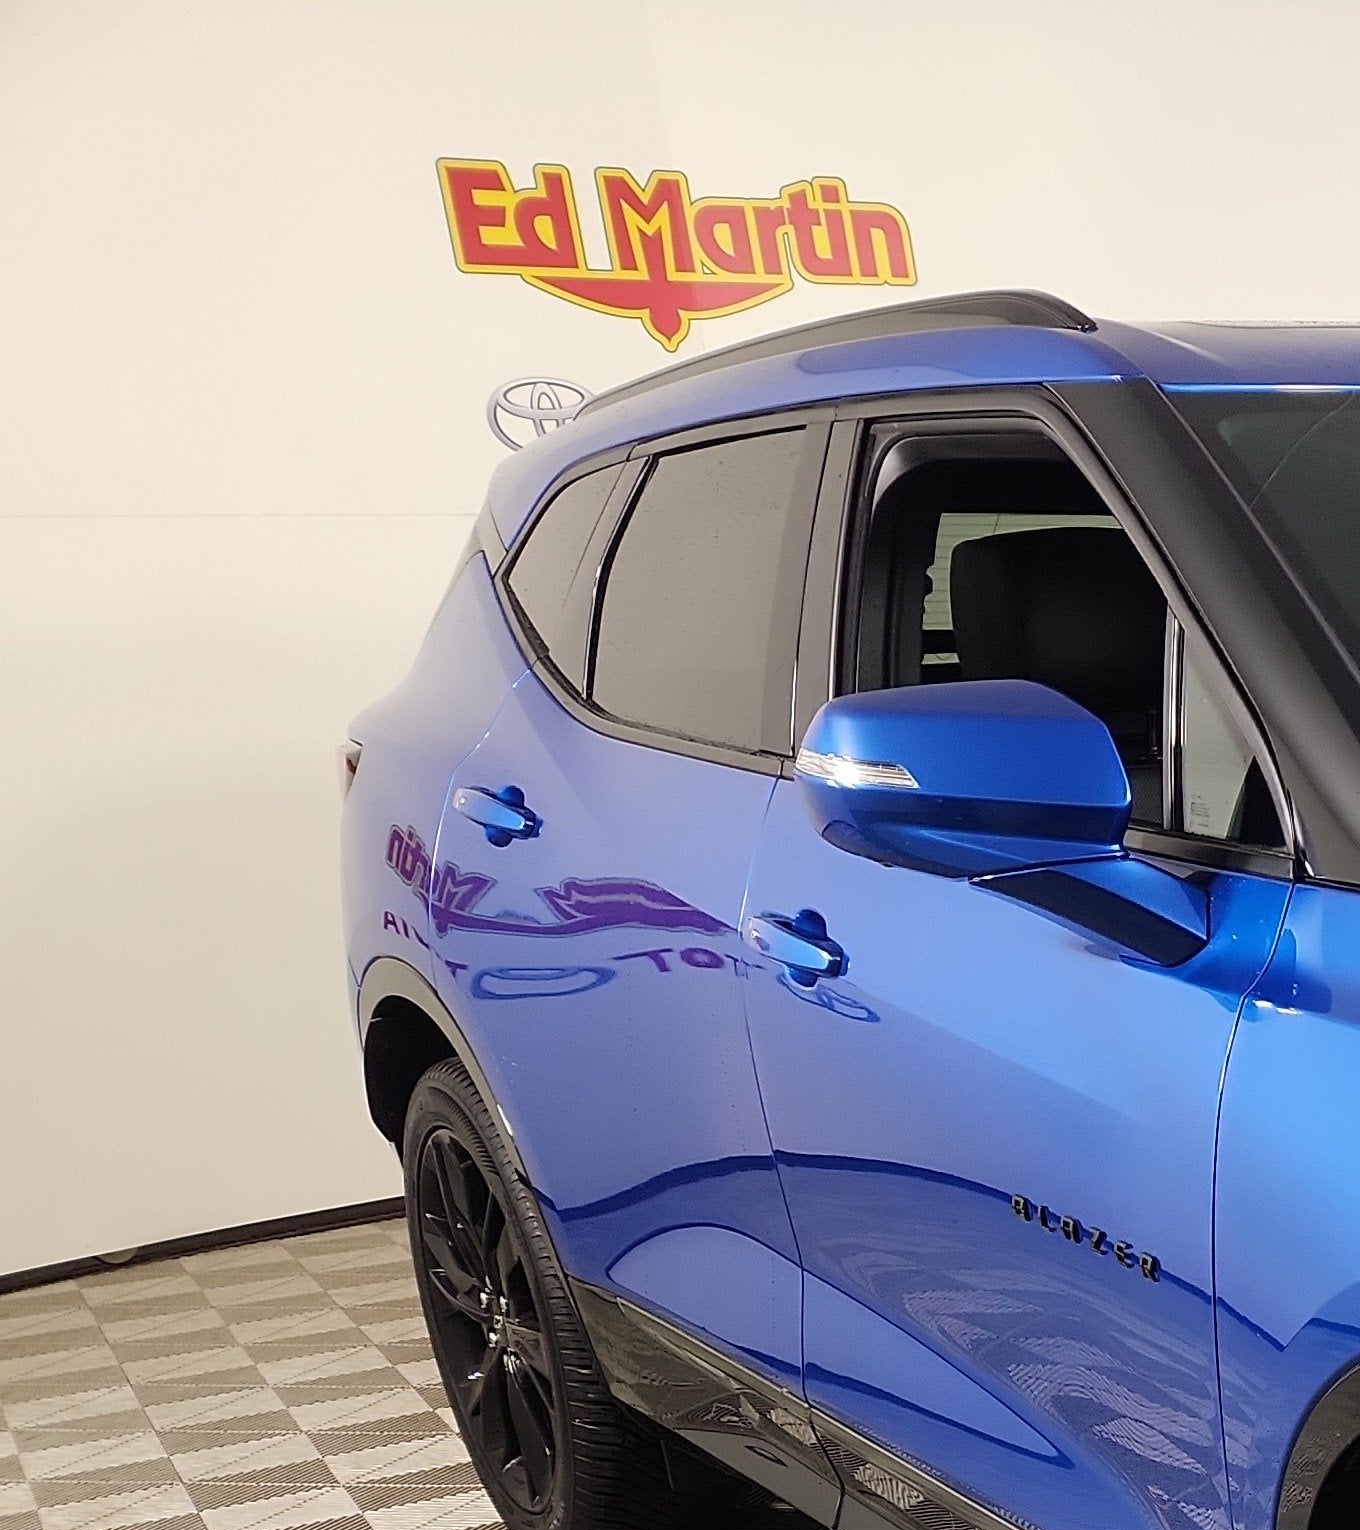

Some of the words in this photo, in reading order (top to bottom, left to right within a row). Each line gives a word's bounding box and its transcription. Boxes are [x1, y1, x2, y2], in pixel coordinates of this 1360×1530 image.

[436, 158, 584, 274] Ed
[595, 167, 918, 288] Martin
[1011, 1193, 1161, 1283] BLAZER
